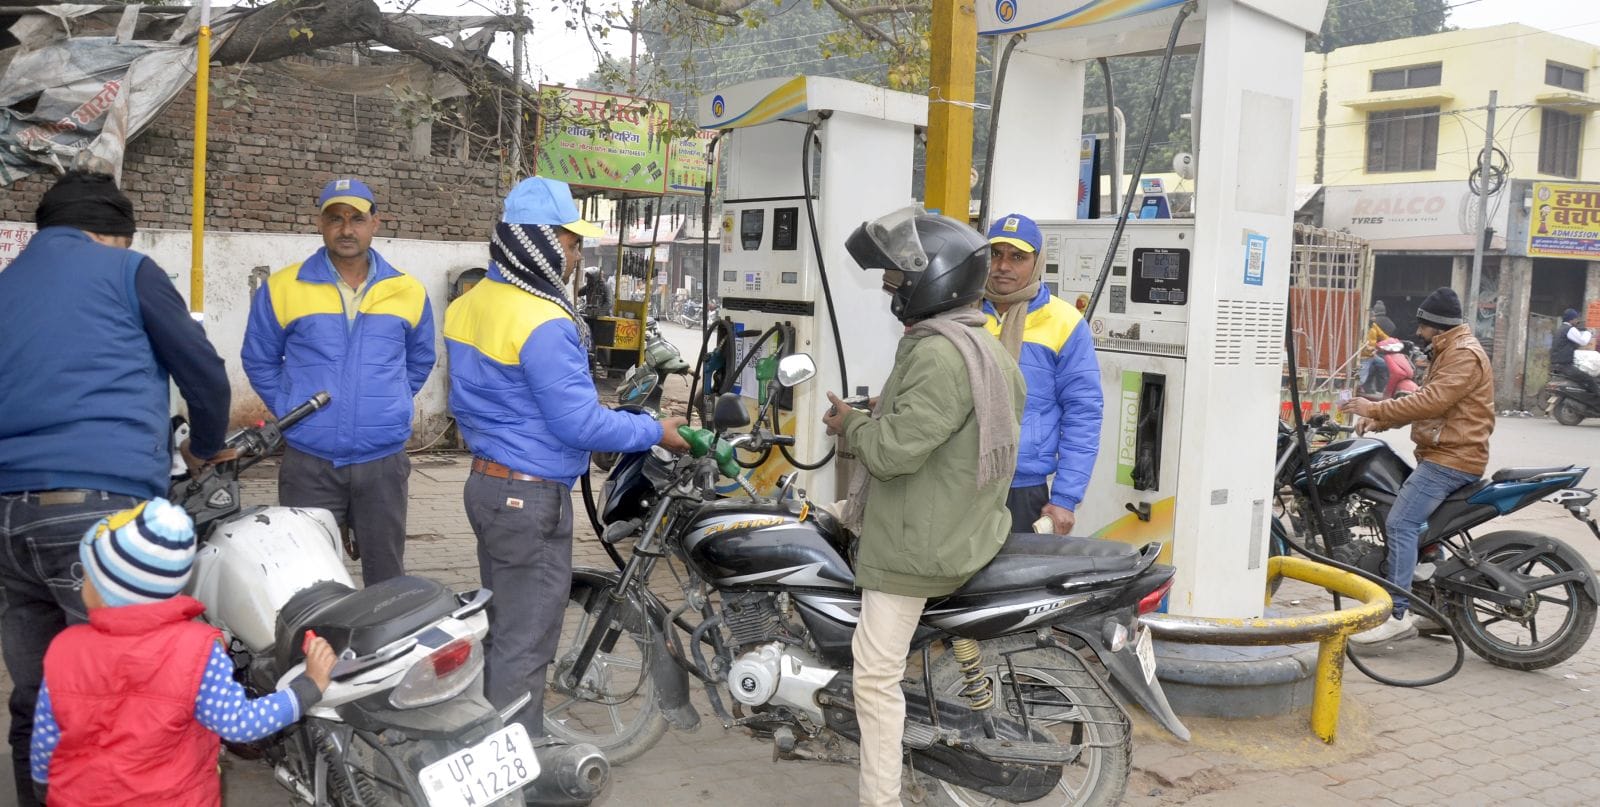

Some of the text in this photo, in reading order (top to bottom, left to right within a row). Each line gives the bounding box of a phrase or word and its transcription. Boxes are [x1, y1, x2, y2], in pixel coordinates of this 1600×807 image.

[1354, 195, 1446, 216] RALCO
[1351, 216, 1384, 225] TYRES
[1552, 229, 1598, 239] ADMISSION
[1120, 396, 1139, 461] Petrol
[704, 516, 784, 536] PLATINA
[447, 733, 517, 782] UP 24
